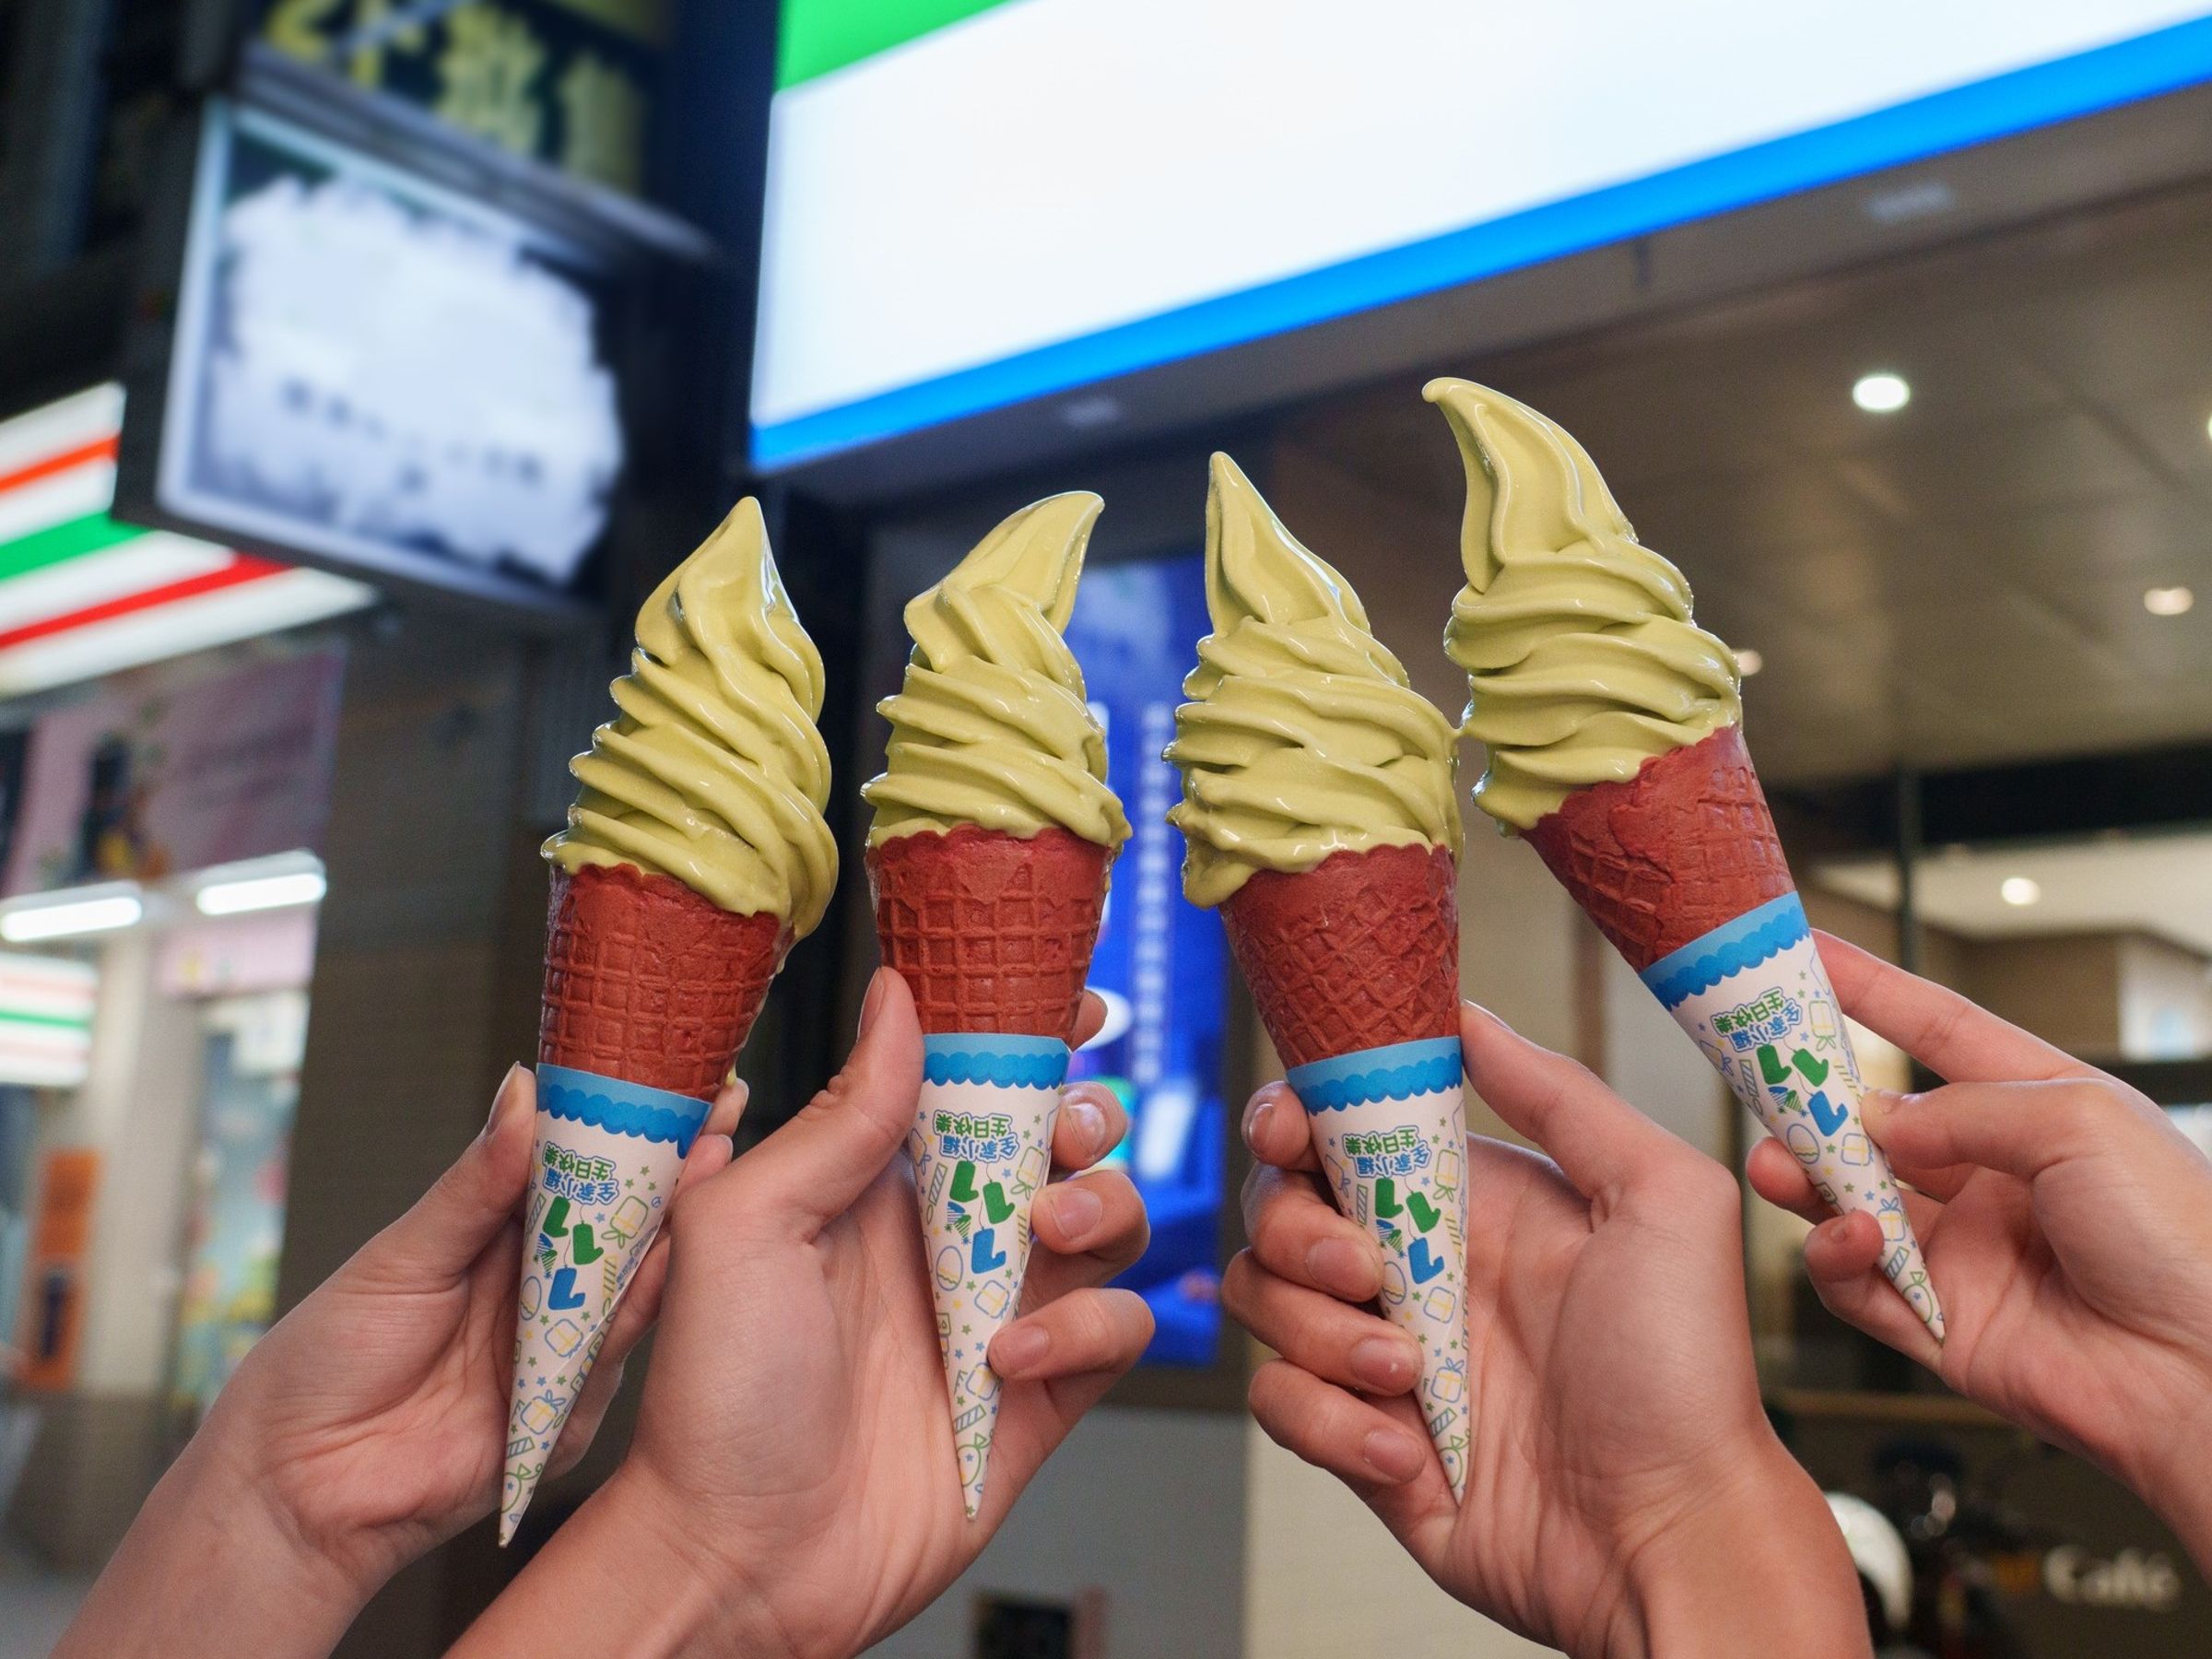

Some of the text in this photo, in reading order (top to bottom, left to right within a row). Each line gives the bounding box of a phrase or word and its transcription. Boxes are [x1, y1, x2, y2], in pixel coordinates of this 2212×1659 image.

[1714, 990, 1783, 1034] 生日快樂
[1731, 1004, 1800, 1050] 全家小編
[935, 1113, 1008, 1138] 生日快樂
[943, 1135, 1015, 1160] 全家小編
[1345, 1129, 1416, 1155] 生日快樂
[545, 1145, 613, 1180] 生日快樂
[1357, 1144, 1429, 1174] 全家小編
[545, 1168, 617, 1202] 全家小編
